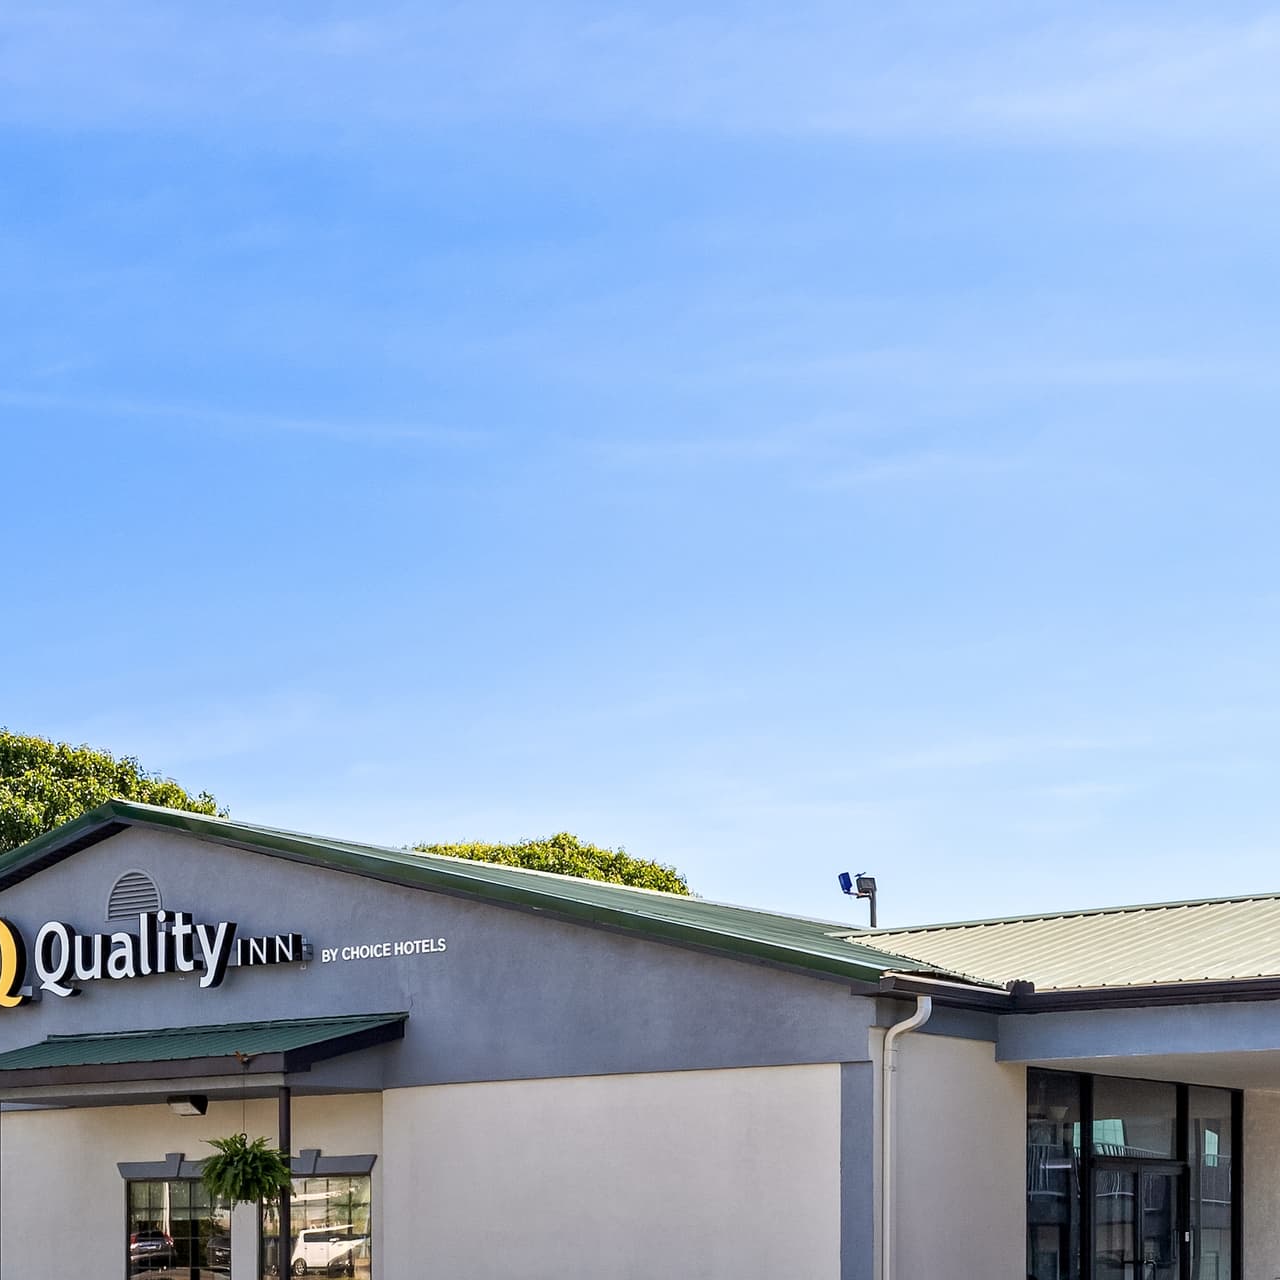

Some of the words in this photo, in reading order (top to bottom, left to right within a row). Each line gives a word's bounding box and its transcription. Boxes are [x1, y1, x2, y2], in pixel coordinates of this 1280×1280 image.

[34, 909, 230, 998] Quality
[236, 932, 294, 967] INN
[321, 948, 339, 963] BY
[341, 942, 392, 961] CHOICE
[394, 938, 447, 956] HOTELS
